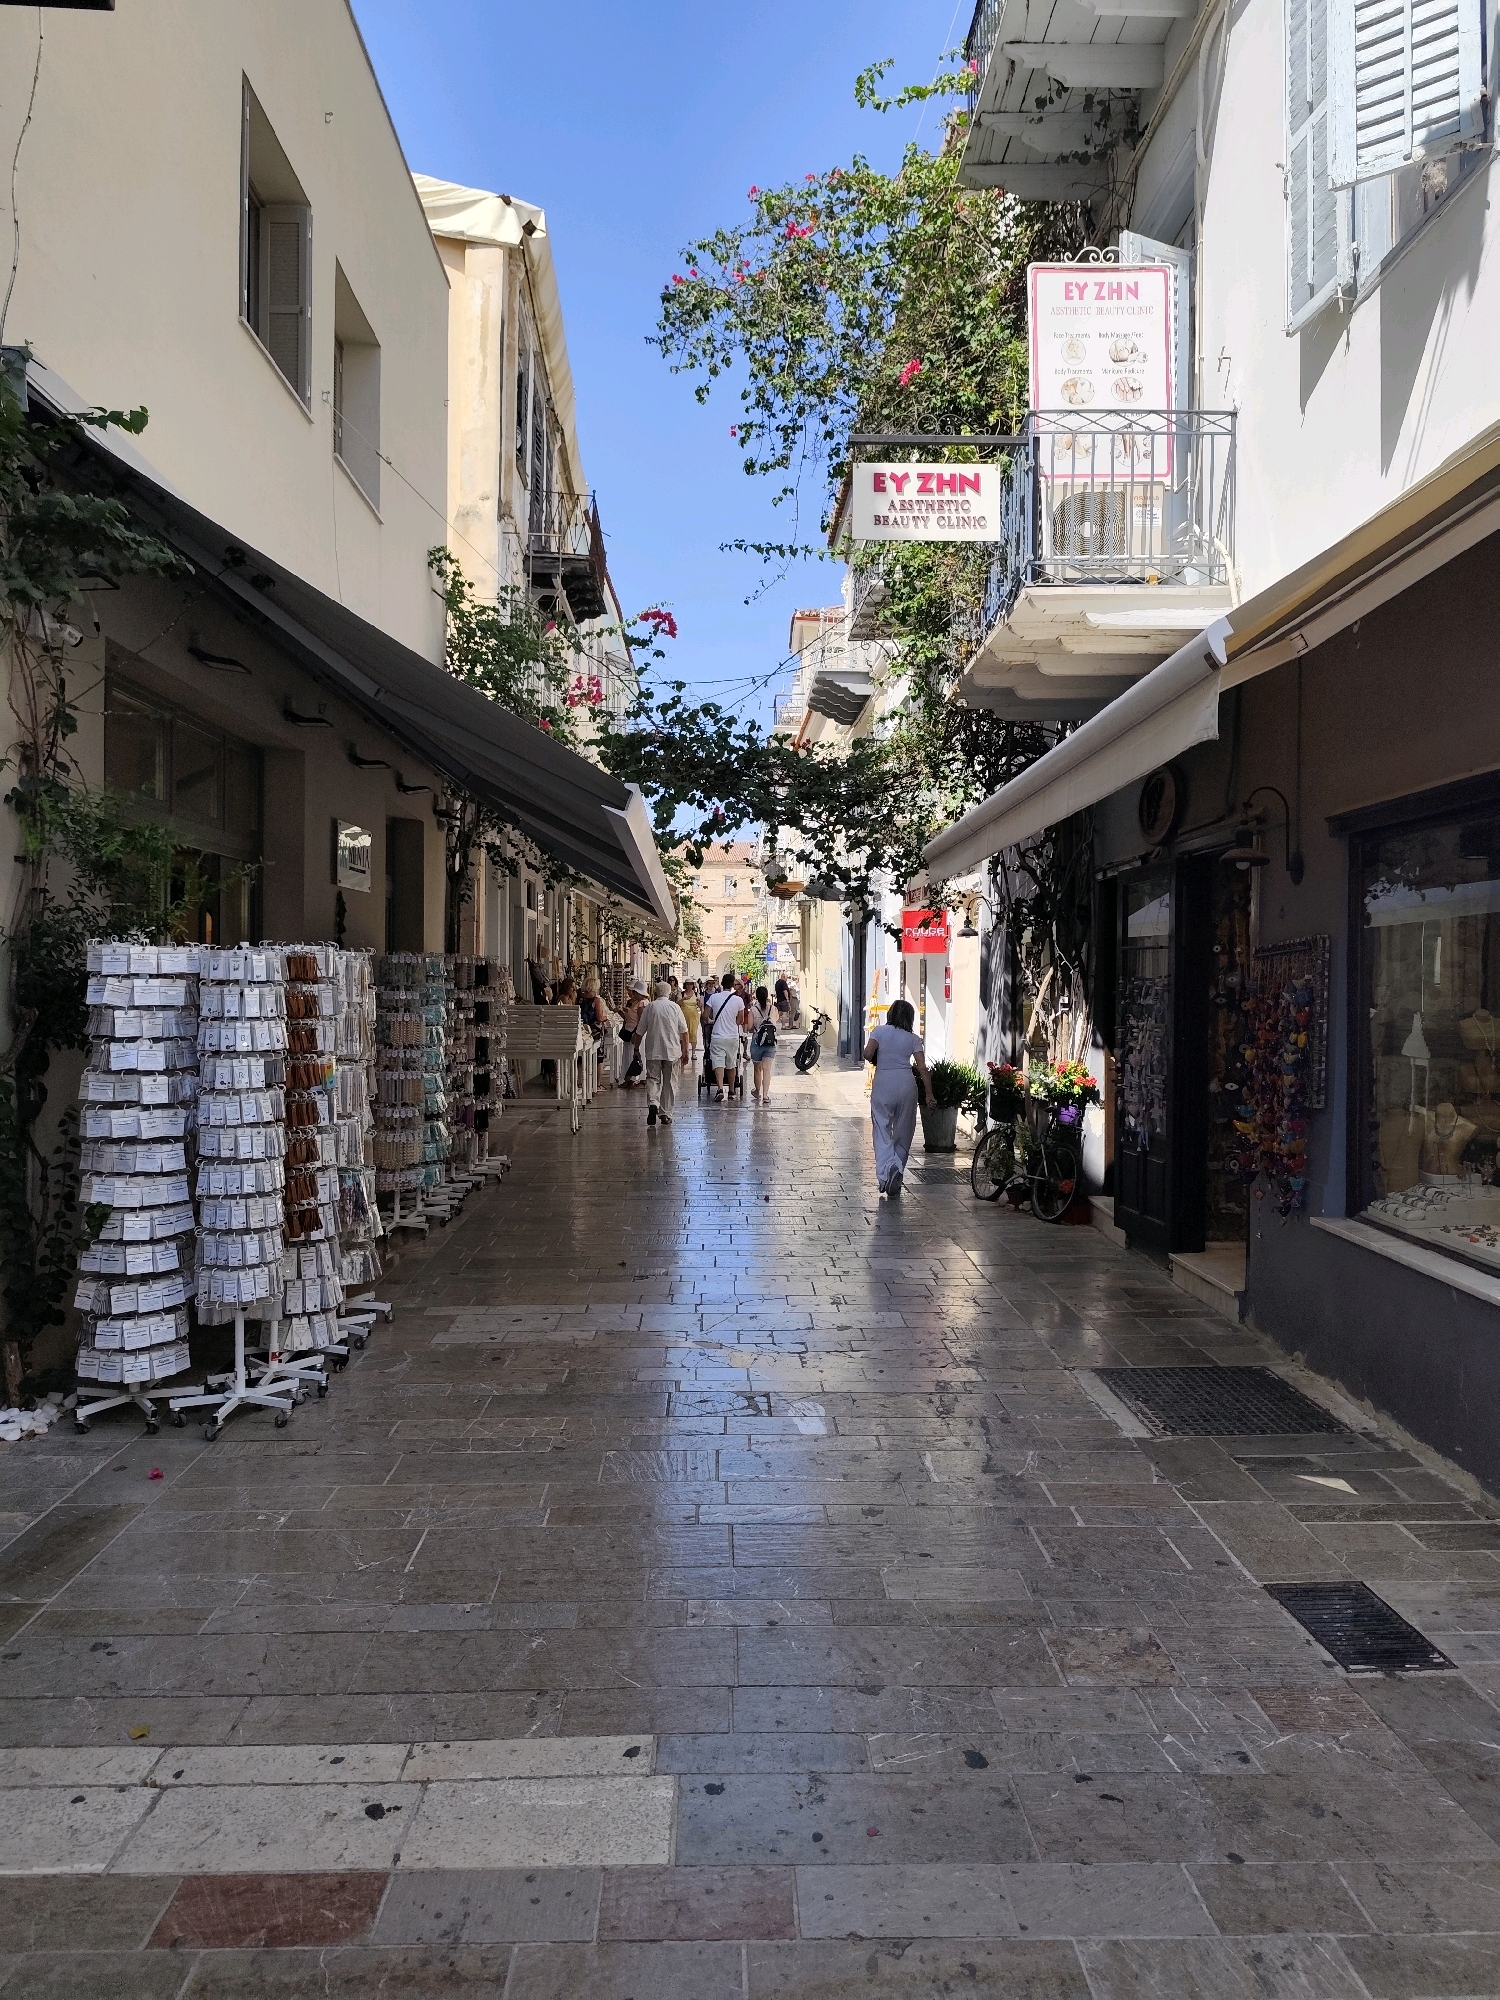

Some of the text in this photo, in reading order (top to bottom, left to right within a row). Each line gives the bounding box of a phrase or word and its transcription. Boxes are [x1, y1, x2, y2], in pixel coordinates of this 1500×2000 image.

[1050, 305, 1154, 316] AESTHETIC BEAUTY CLINIC
[888, 499, 972, 514] AESTHETIC
[874, 514, 988, 530] BEAUTY CLINIC
